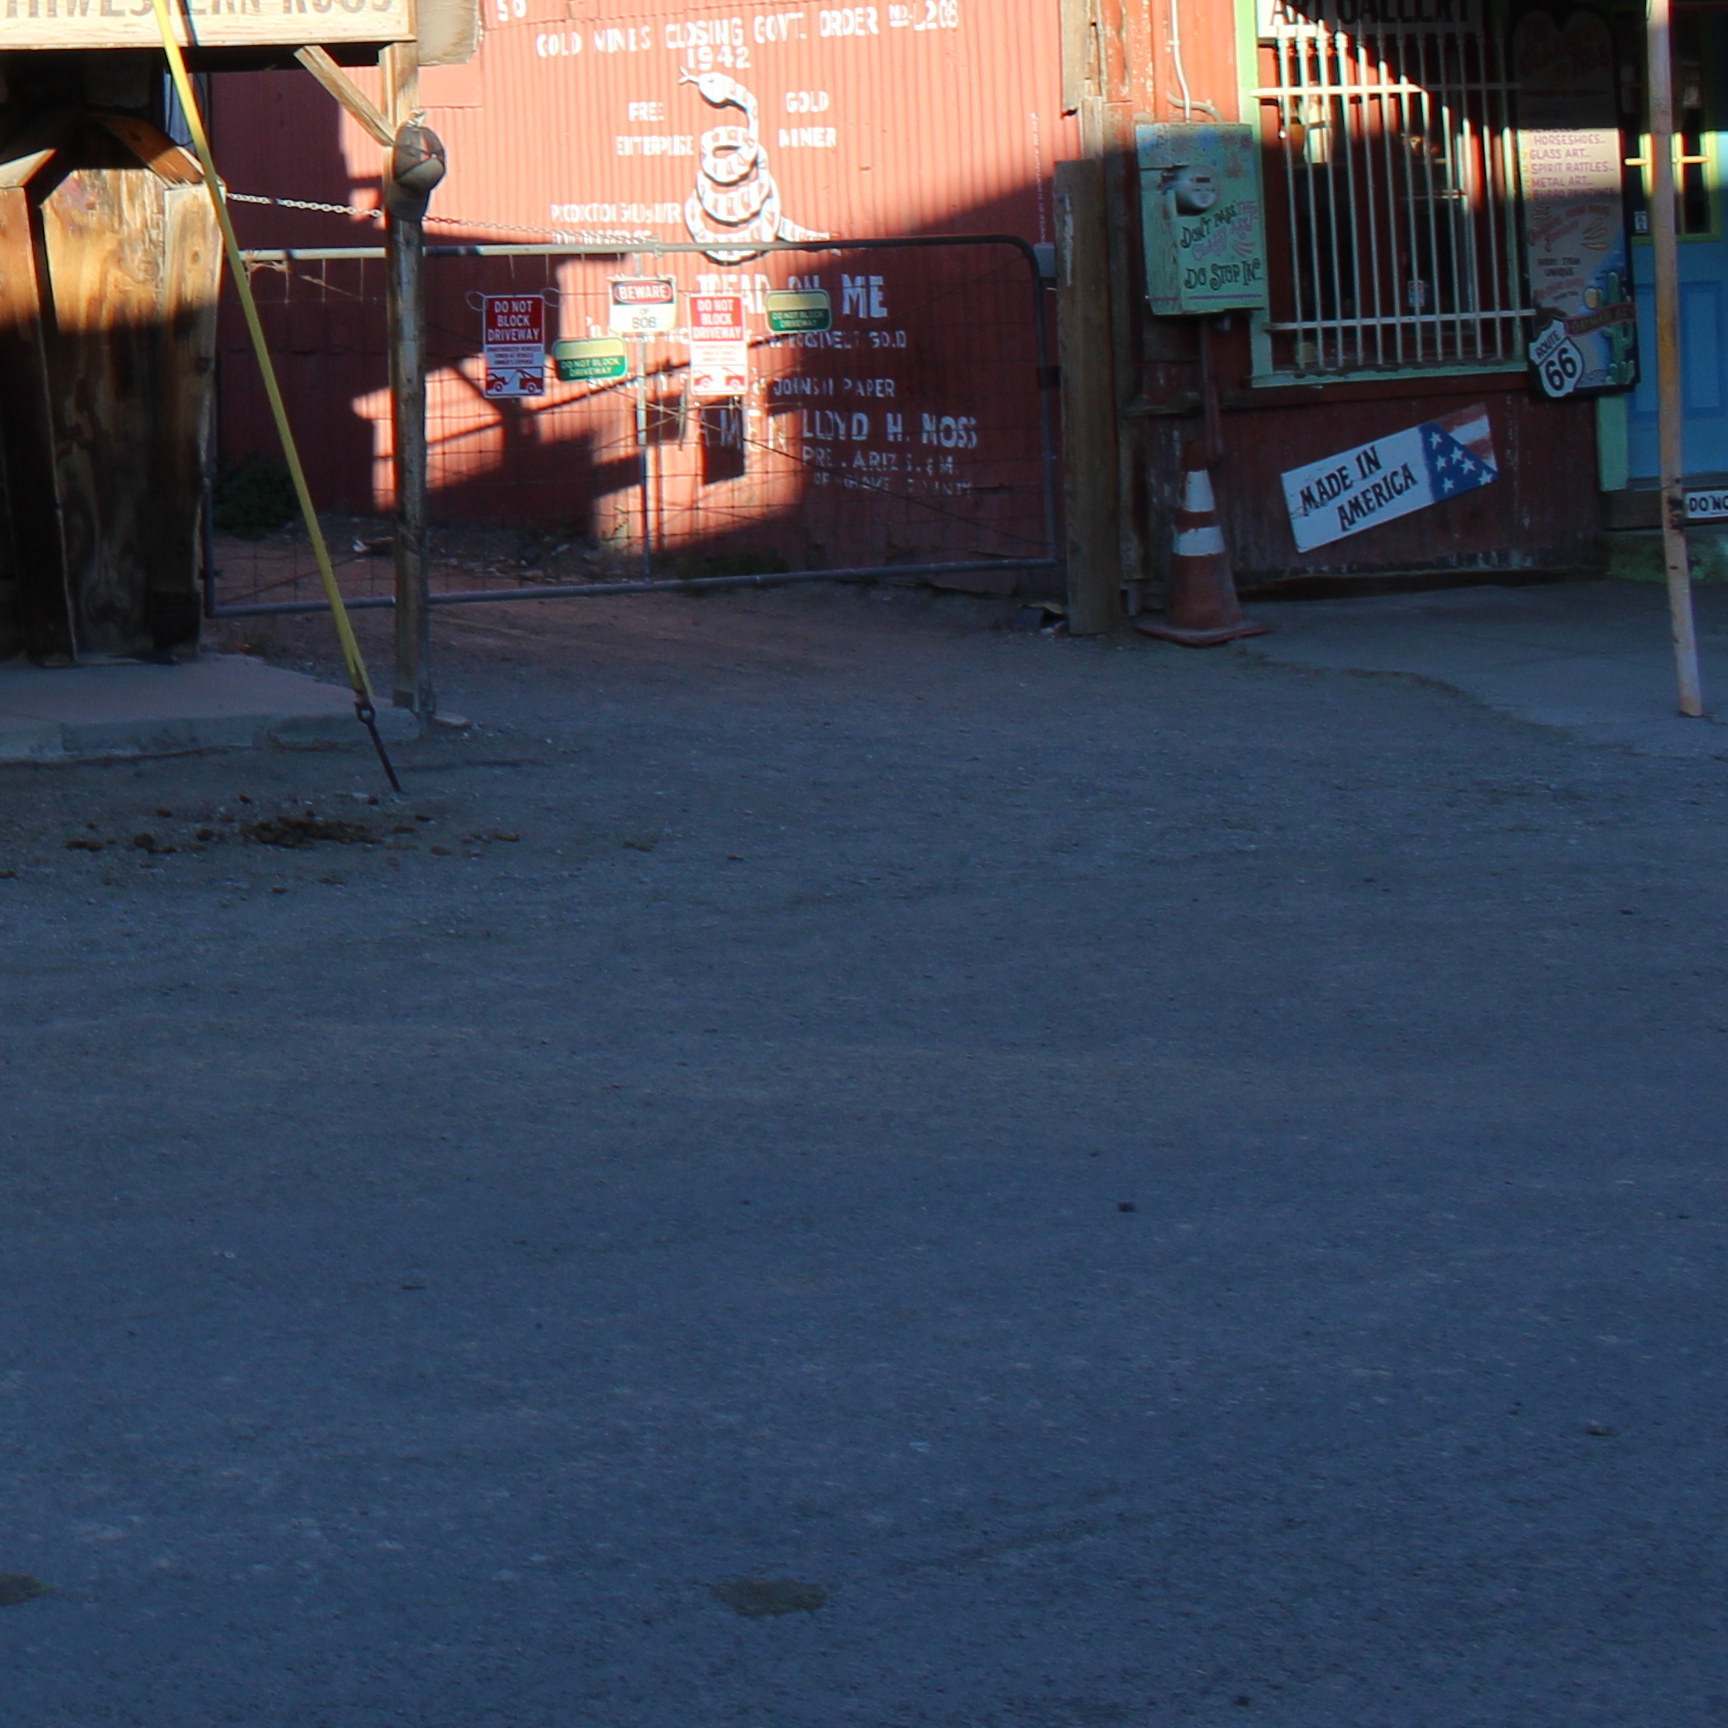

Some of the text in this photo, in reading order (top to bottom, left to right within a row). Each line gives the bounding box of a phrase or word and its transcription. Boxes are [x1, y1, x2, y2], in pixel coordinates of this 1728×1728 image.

[536, 31, 582, 57] GOLD
[664, 17, 743, 49] CLOSING
[819, 6, 880, 38] ORDER
[686, 45, 751, 71] 1942
[785, 91, 829, 113] GOLD
[1182, 265, 1208, 290] DO
[1208, 263, 1241, 291] STOP
[618, 283, 667, 301] BEWARE
[840, 273, 888, 319] ME
[494, 300, 533, 313] DO NOT
[697, 299, 734, 312] DO NOT
[496, 314, 530, 328] BLOCK
[631, 316, 658, 329] BOB
[700, 313, 733, 326] BLOCK
[800, 311, 825, 320] BLOCK
[487, 328, 540, 342] DRIVEWAY
[693, 326, 742, 340] DRIVEWAY
[1534, 329, 1561, 360] ROUTE
[592, 358, 621, 368] BLOCK
[1544, 346, 1578, 392] 66
[569, 366, 613, 378] DRIVEWAY
[1300, 445, 1383, 517] MADE IN
[1335, 463, 1418, 531] AMERICA
[1688, 496, 1709, 513] DO
